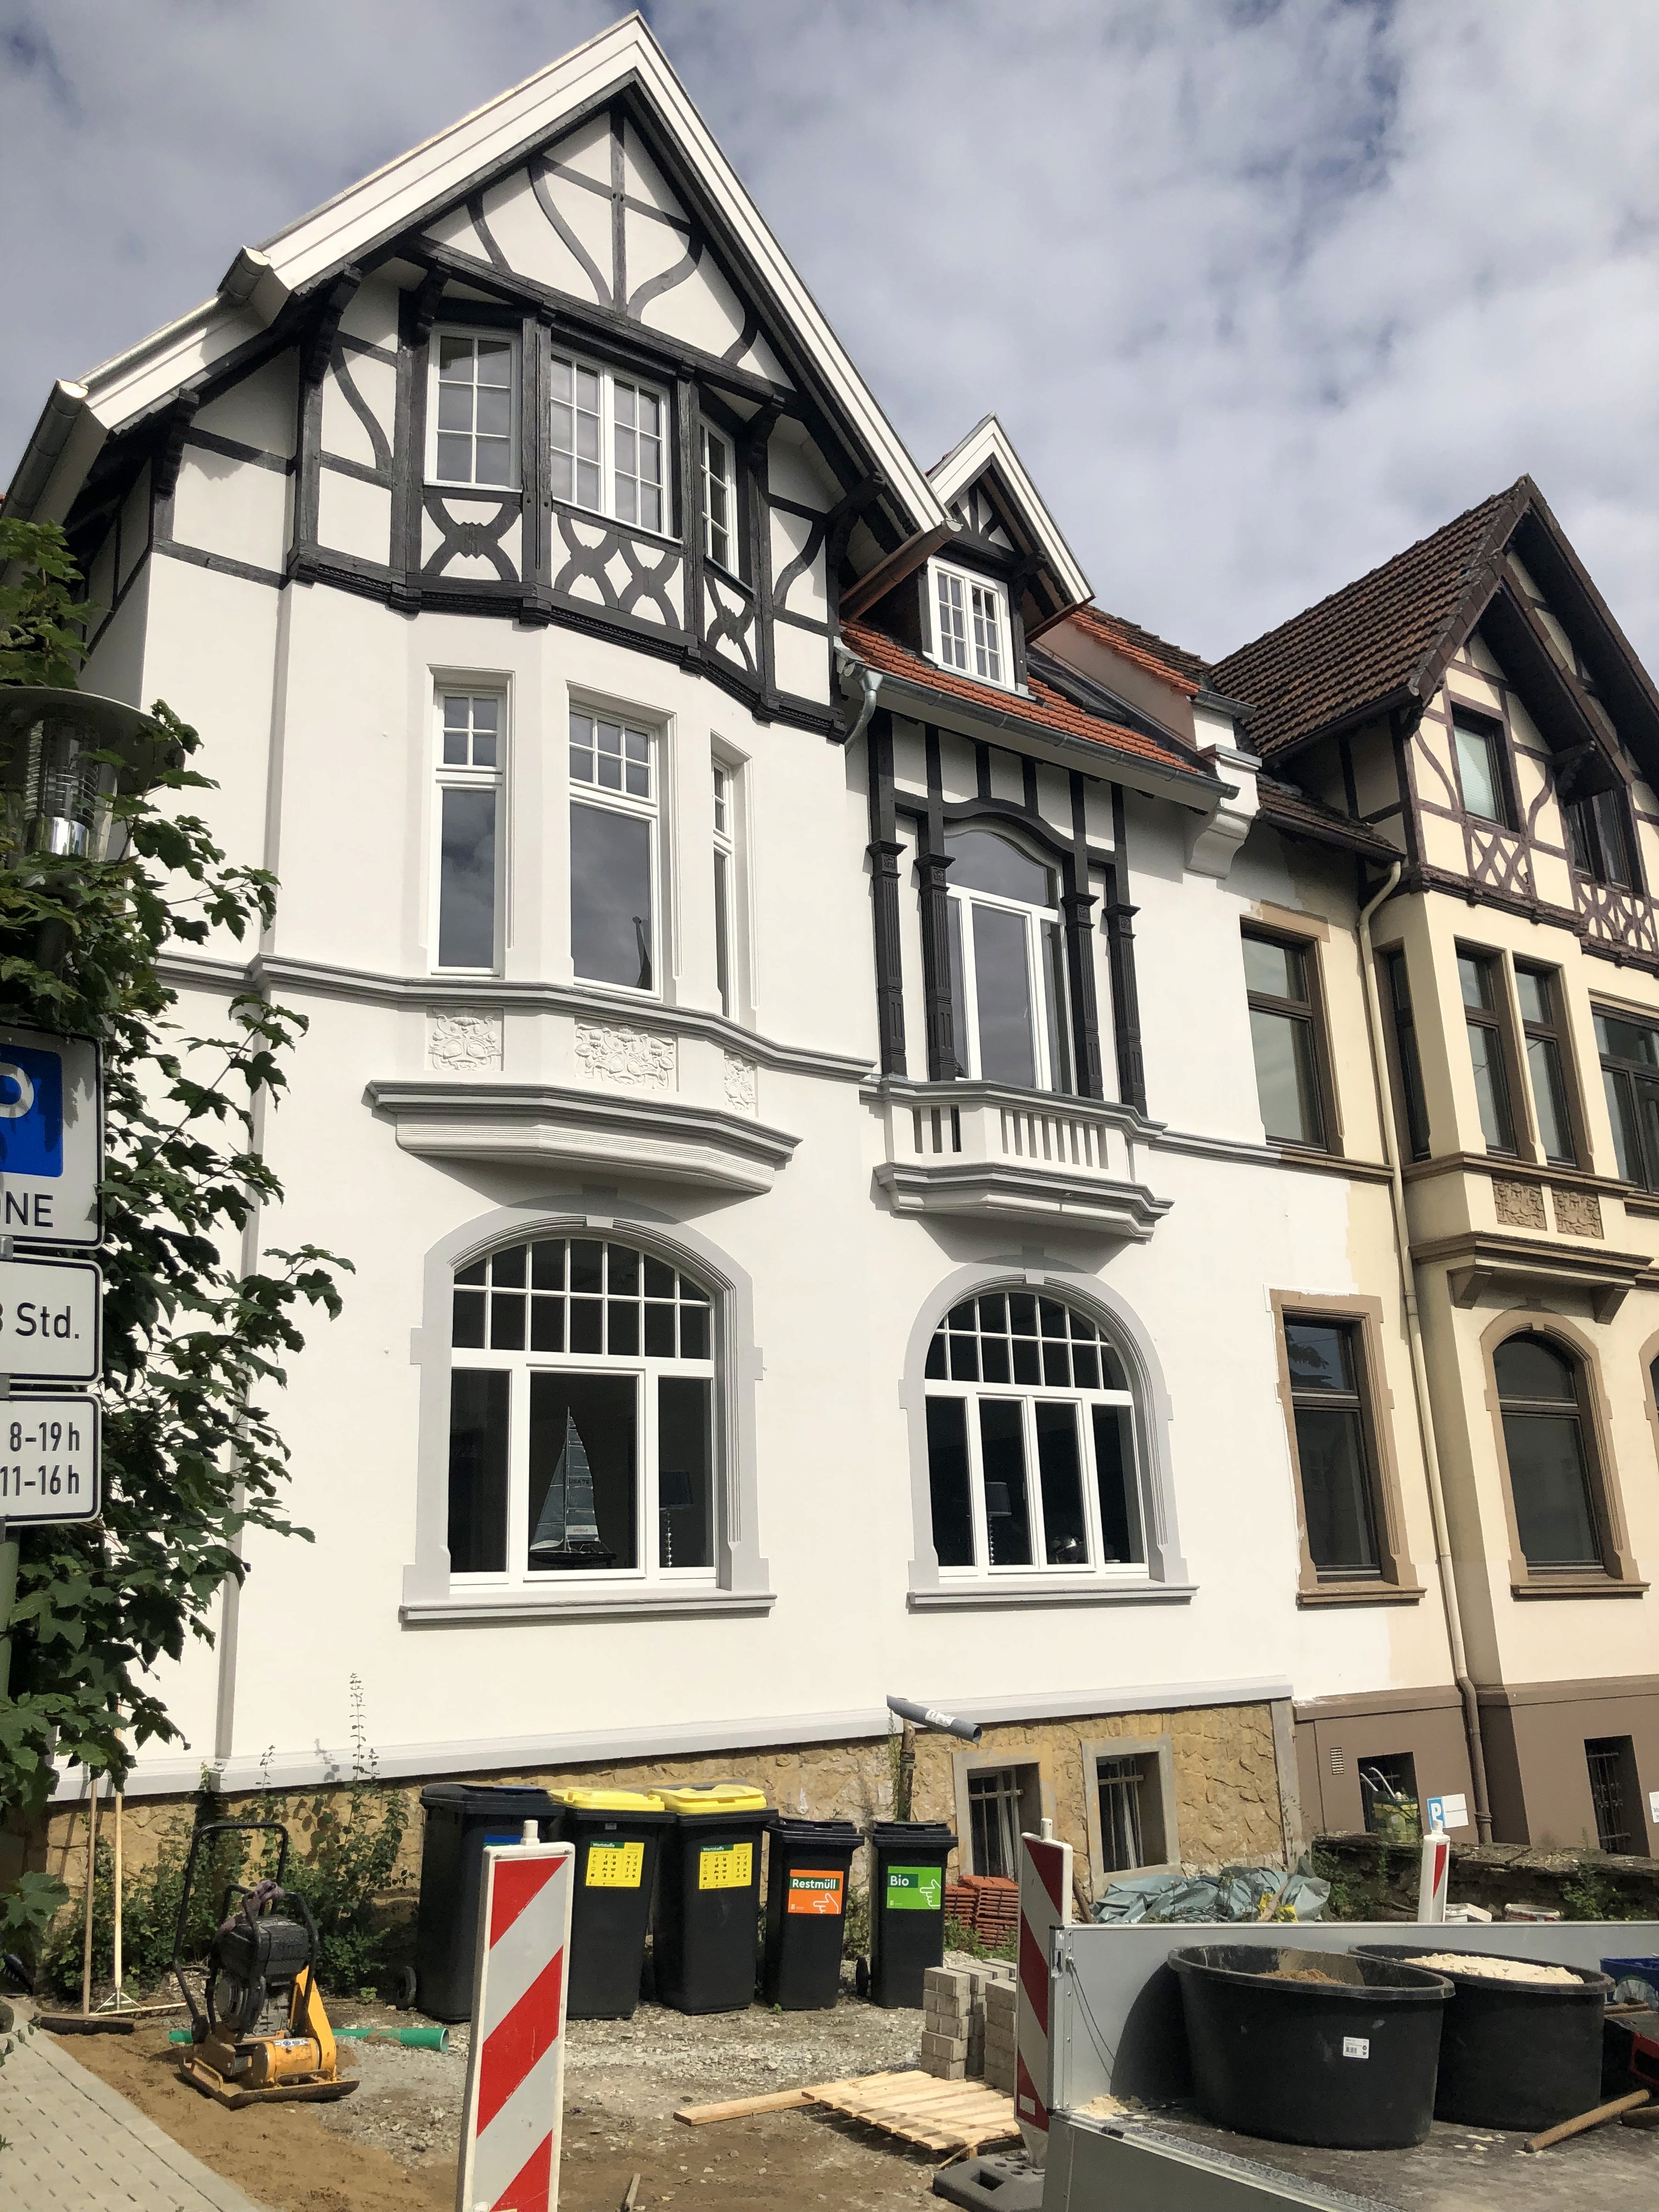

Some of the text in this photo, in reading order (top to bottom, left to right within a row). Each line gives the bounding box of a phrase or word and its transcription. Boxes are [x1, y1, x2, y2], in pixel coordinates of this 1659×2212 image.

[0, 1190, 54, 1228] NE
[15, 1302, 80, 1339] Std.
[792, 1878, 836, 1889] Restmüll
[890, 1874, 909, 1886] Bio
